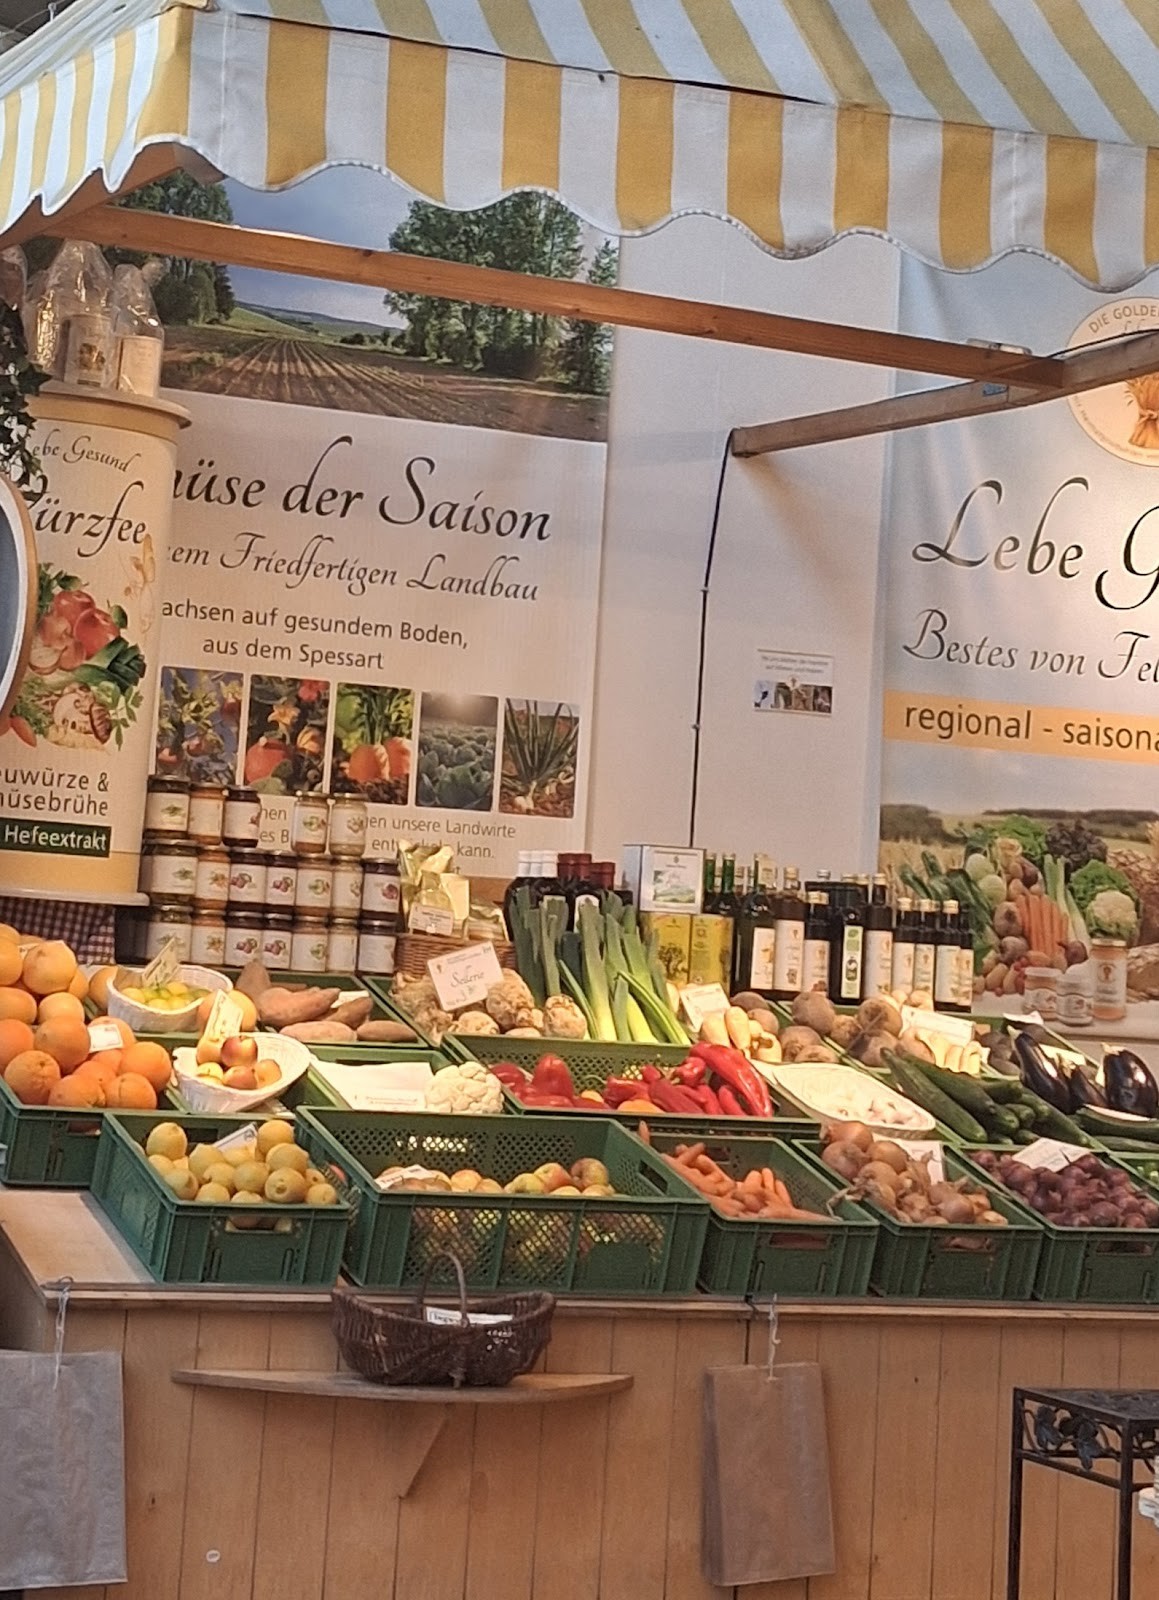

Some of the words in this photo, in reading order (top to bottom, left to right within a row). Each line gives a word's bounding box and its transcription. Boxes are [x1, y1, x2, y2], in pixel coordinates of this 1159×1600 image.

[1088, 313, 1110, 333] DIE
[1113, 304, 1159, 320] GOLDE
[32, 428, 60, 456] ebe
[62, 435, 141, 472] Gesund
[282, 436, 364, 518] der
[379, 456, 551, 541] Saison
[912, 476, 1089, 578] Lebe
[168, 546, 210, 566] em
[220, 532, 397, 596] Friedfertigen
[406, 554, 538, 600] Landbau
[242, 607, 279, 627] auf
[284, 616, 393, 639] gesundem
[400, 621, 467, 649] Boden,
[902, 608, 1018, 669] Bestes
[1029, 650, 1086, 676] von
[203, 638, 239, 656] aus
[245, 638, 292, 661] dem
[299, 644, 384, 669] Spessart
[905, 704, 1032, 741] regional
[0, 767, 90, 791] uwürze
[97, 771, 109, 793] &
[4, 824, 107, 852] Hefeextrakt
[392, 818, 441, 833] unsere
[445, 820, 517, 839] Landwirte
[456, 841, 495, 860] kann.
